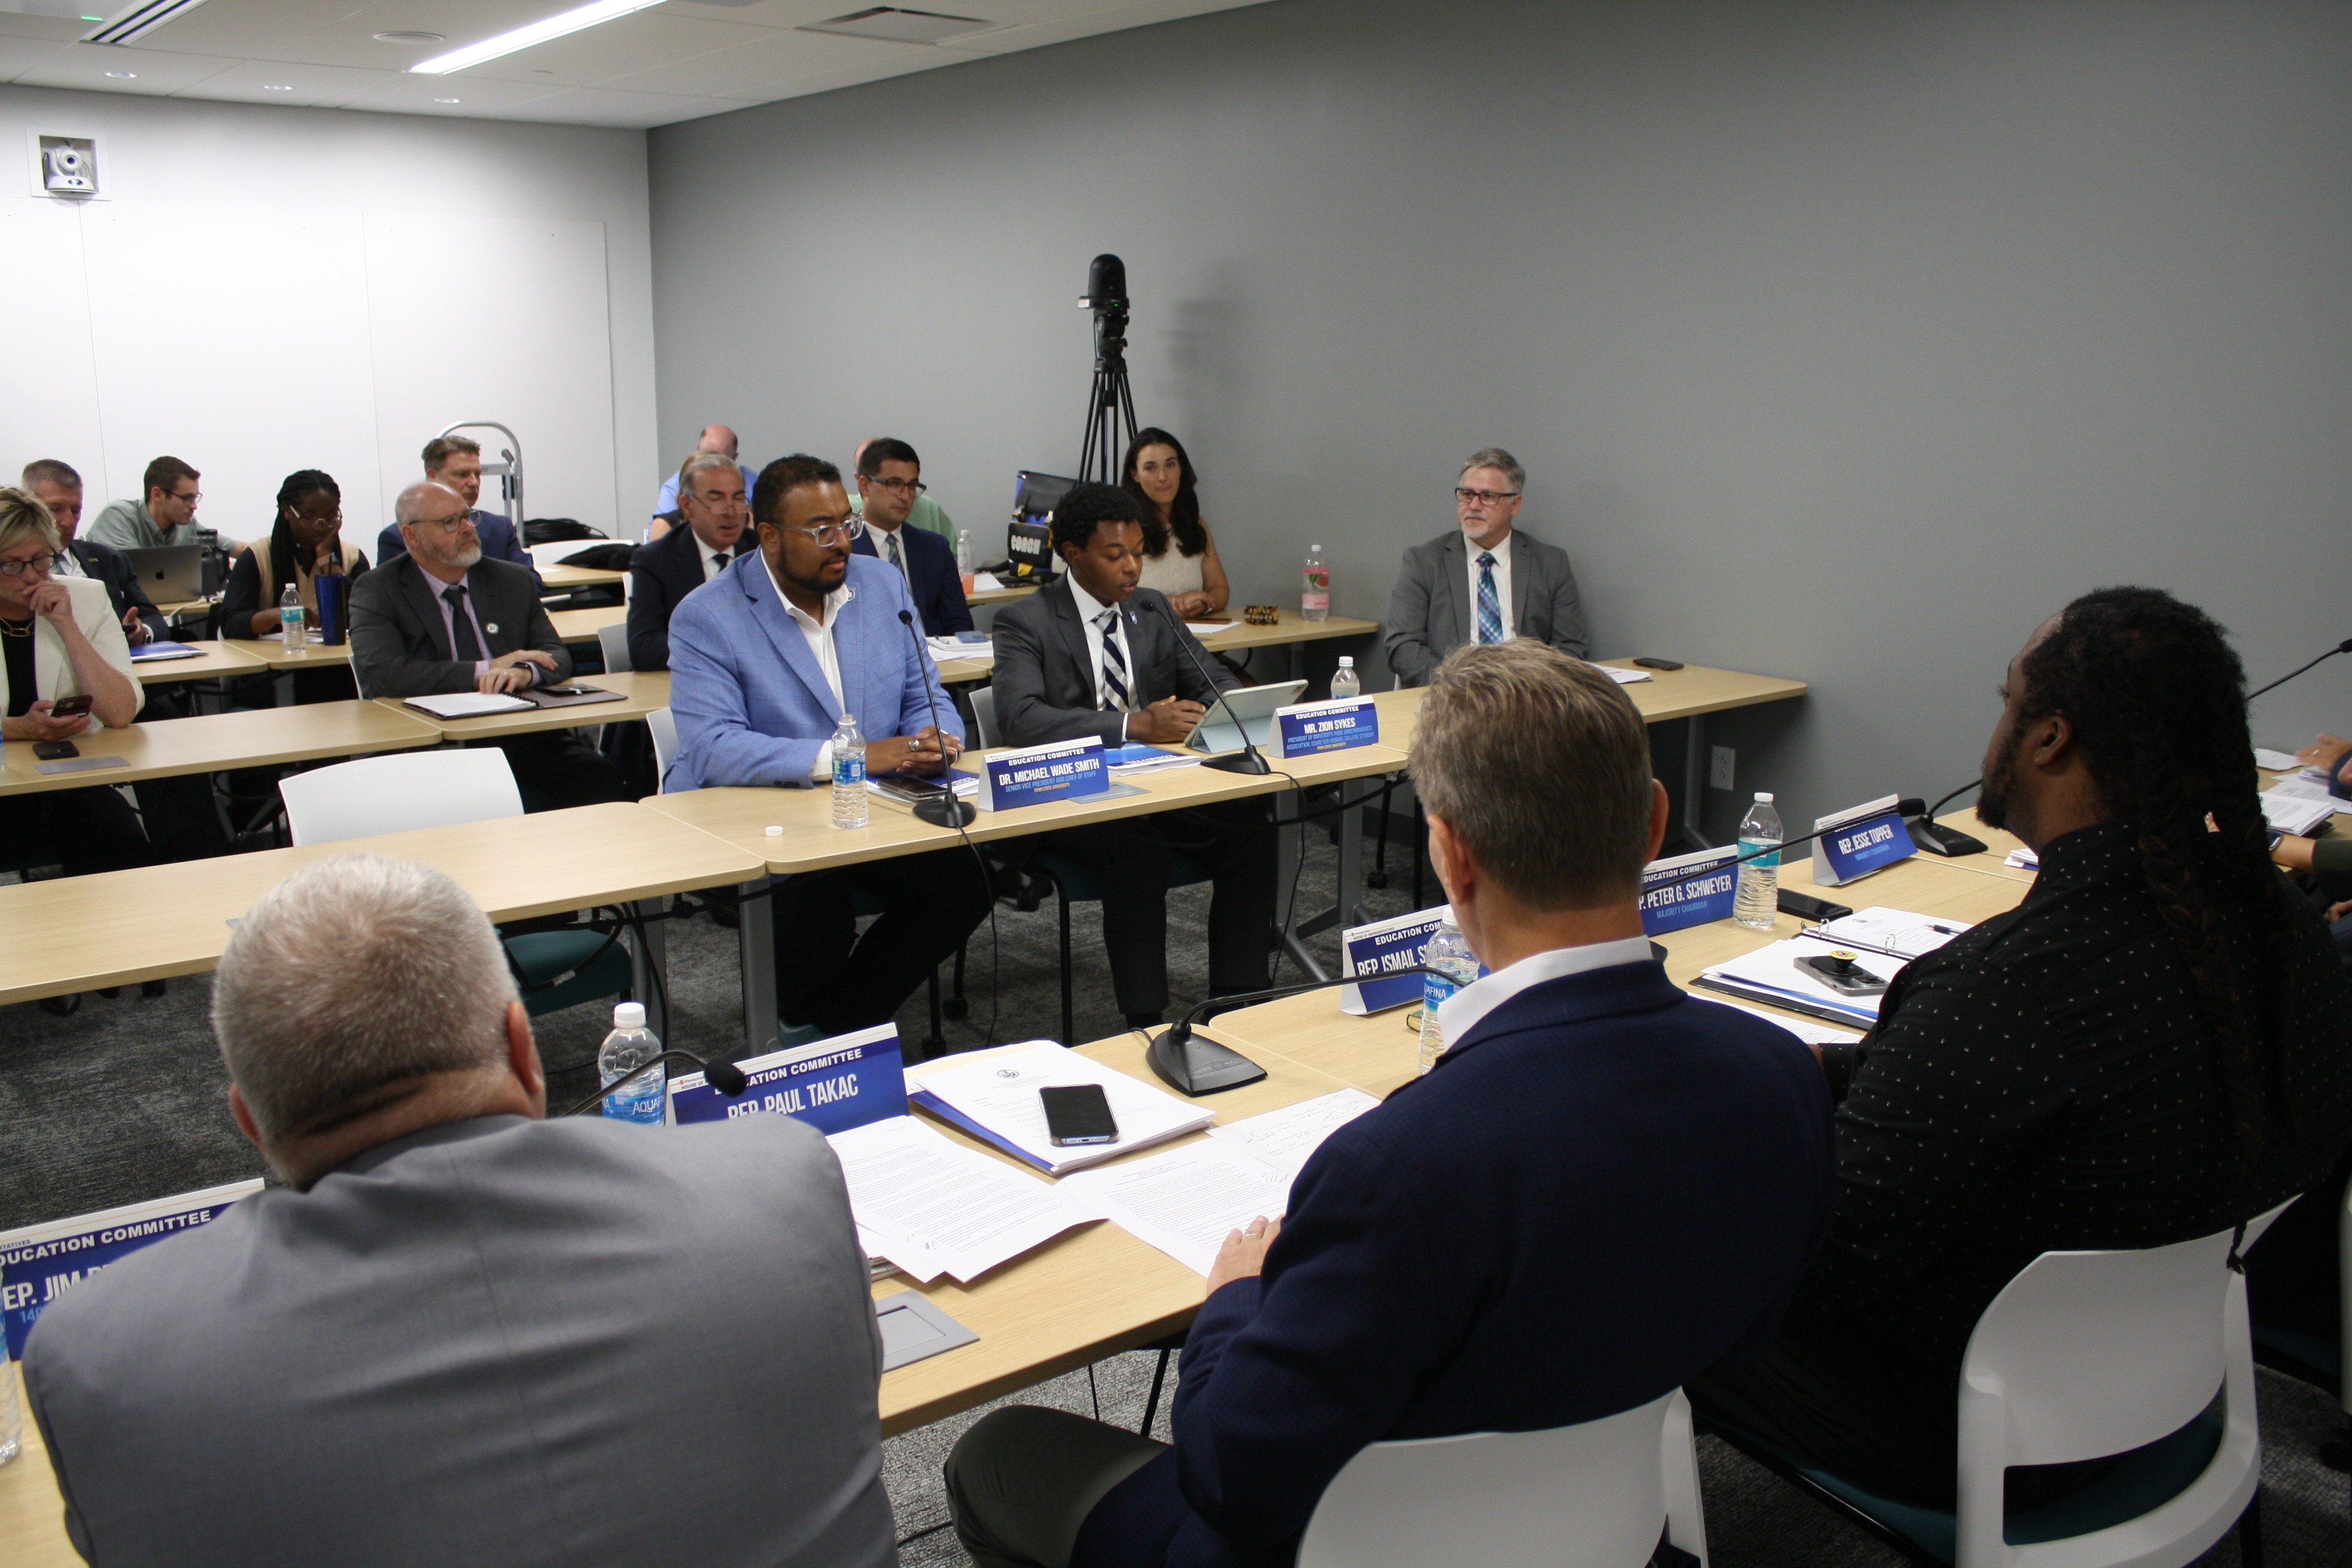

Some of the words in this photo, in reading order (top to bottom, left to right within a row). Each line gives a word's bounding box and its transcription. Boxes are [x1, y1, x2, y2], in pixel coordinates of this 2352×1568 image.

[1296, 710, 1327, 720] EDUCATION
[1328, 705, 1359, 715] COMMITTEE
[1304, 724, 1318, 734] MR.
[1319, 720, 1333, 732] ZION
[1334, 717, 1356, 730] SYKES
[1008, 755, 1047, 766] EDUCATION
[1047, 748, 1085, 760] COMMITTEE
[999, 774, 1013, 786] DR.
[1014, 767, 1050, 783] MICHAEL
[1050, 762, 1074, 777] WADE
[1074, 758, 1100, 773] SMITH
[1005, 783, 1021, 792] SENIOR
[1032, 778, 1055, 788] PRESIDENT
[1838, 838, 1855, 855] REP.
[1851, 831, 1872, 851] JESSE
[1868, 824, 1894, 844] TOPPER
[1679, 860, 1719, 875] COMMITTEE
[1647, 887, 1674, 908] PETER
[1676, 885, 1685, 902] G.
[1686, 875, 1732, 900] SCHWEYER
[1656, 906, 1681, 919] MAJORITY
[1682, 900, 1708, 913] CHAIRMAN
[1375, 926, 1422, 946] EDUCATION
[1381, 949, 1418, 972] ISMAIL
[1423, 982, 1446, 1000] UAFINA
[790, 1048, 862, 1075] COMMITTEE
[764, 1091, 806, 1115] PAUL
[806, 1073, 858, 1106] TAKAC
[100, 1209, 211, 1244] COMMITTEE
[2, 1282, 37, 1311] EP.
[44, 1270, 81, 1301] JIM
